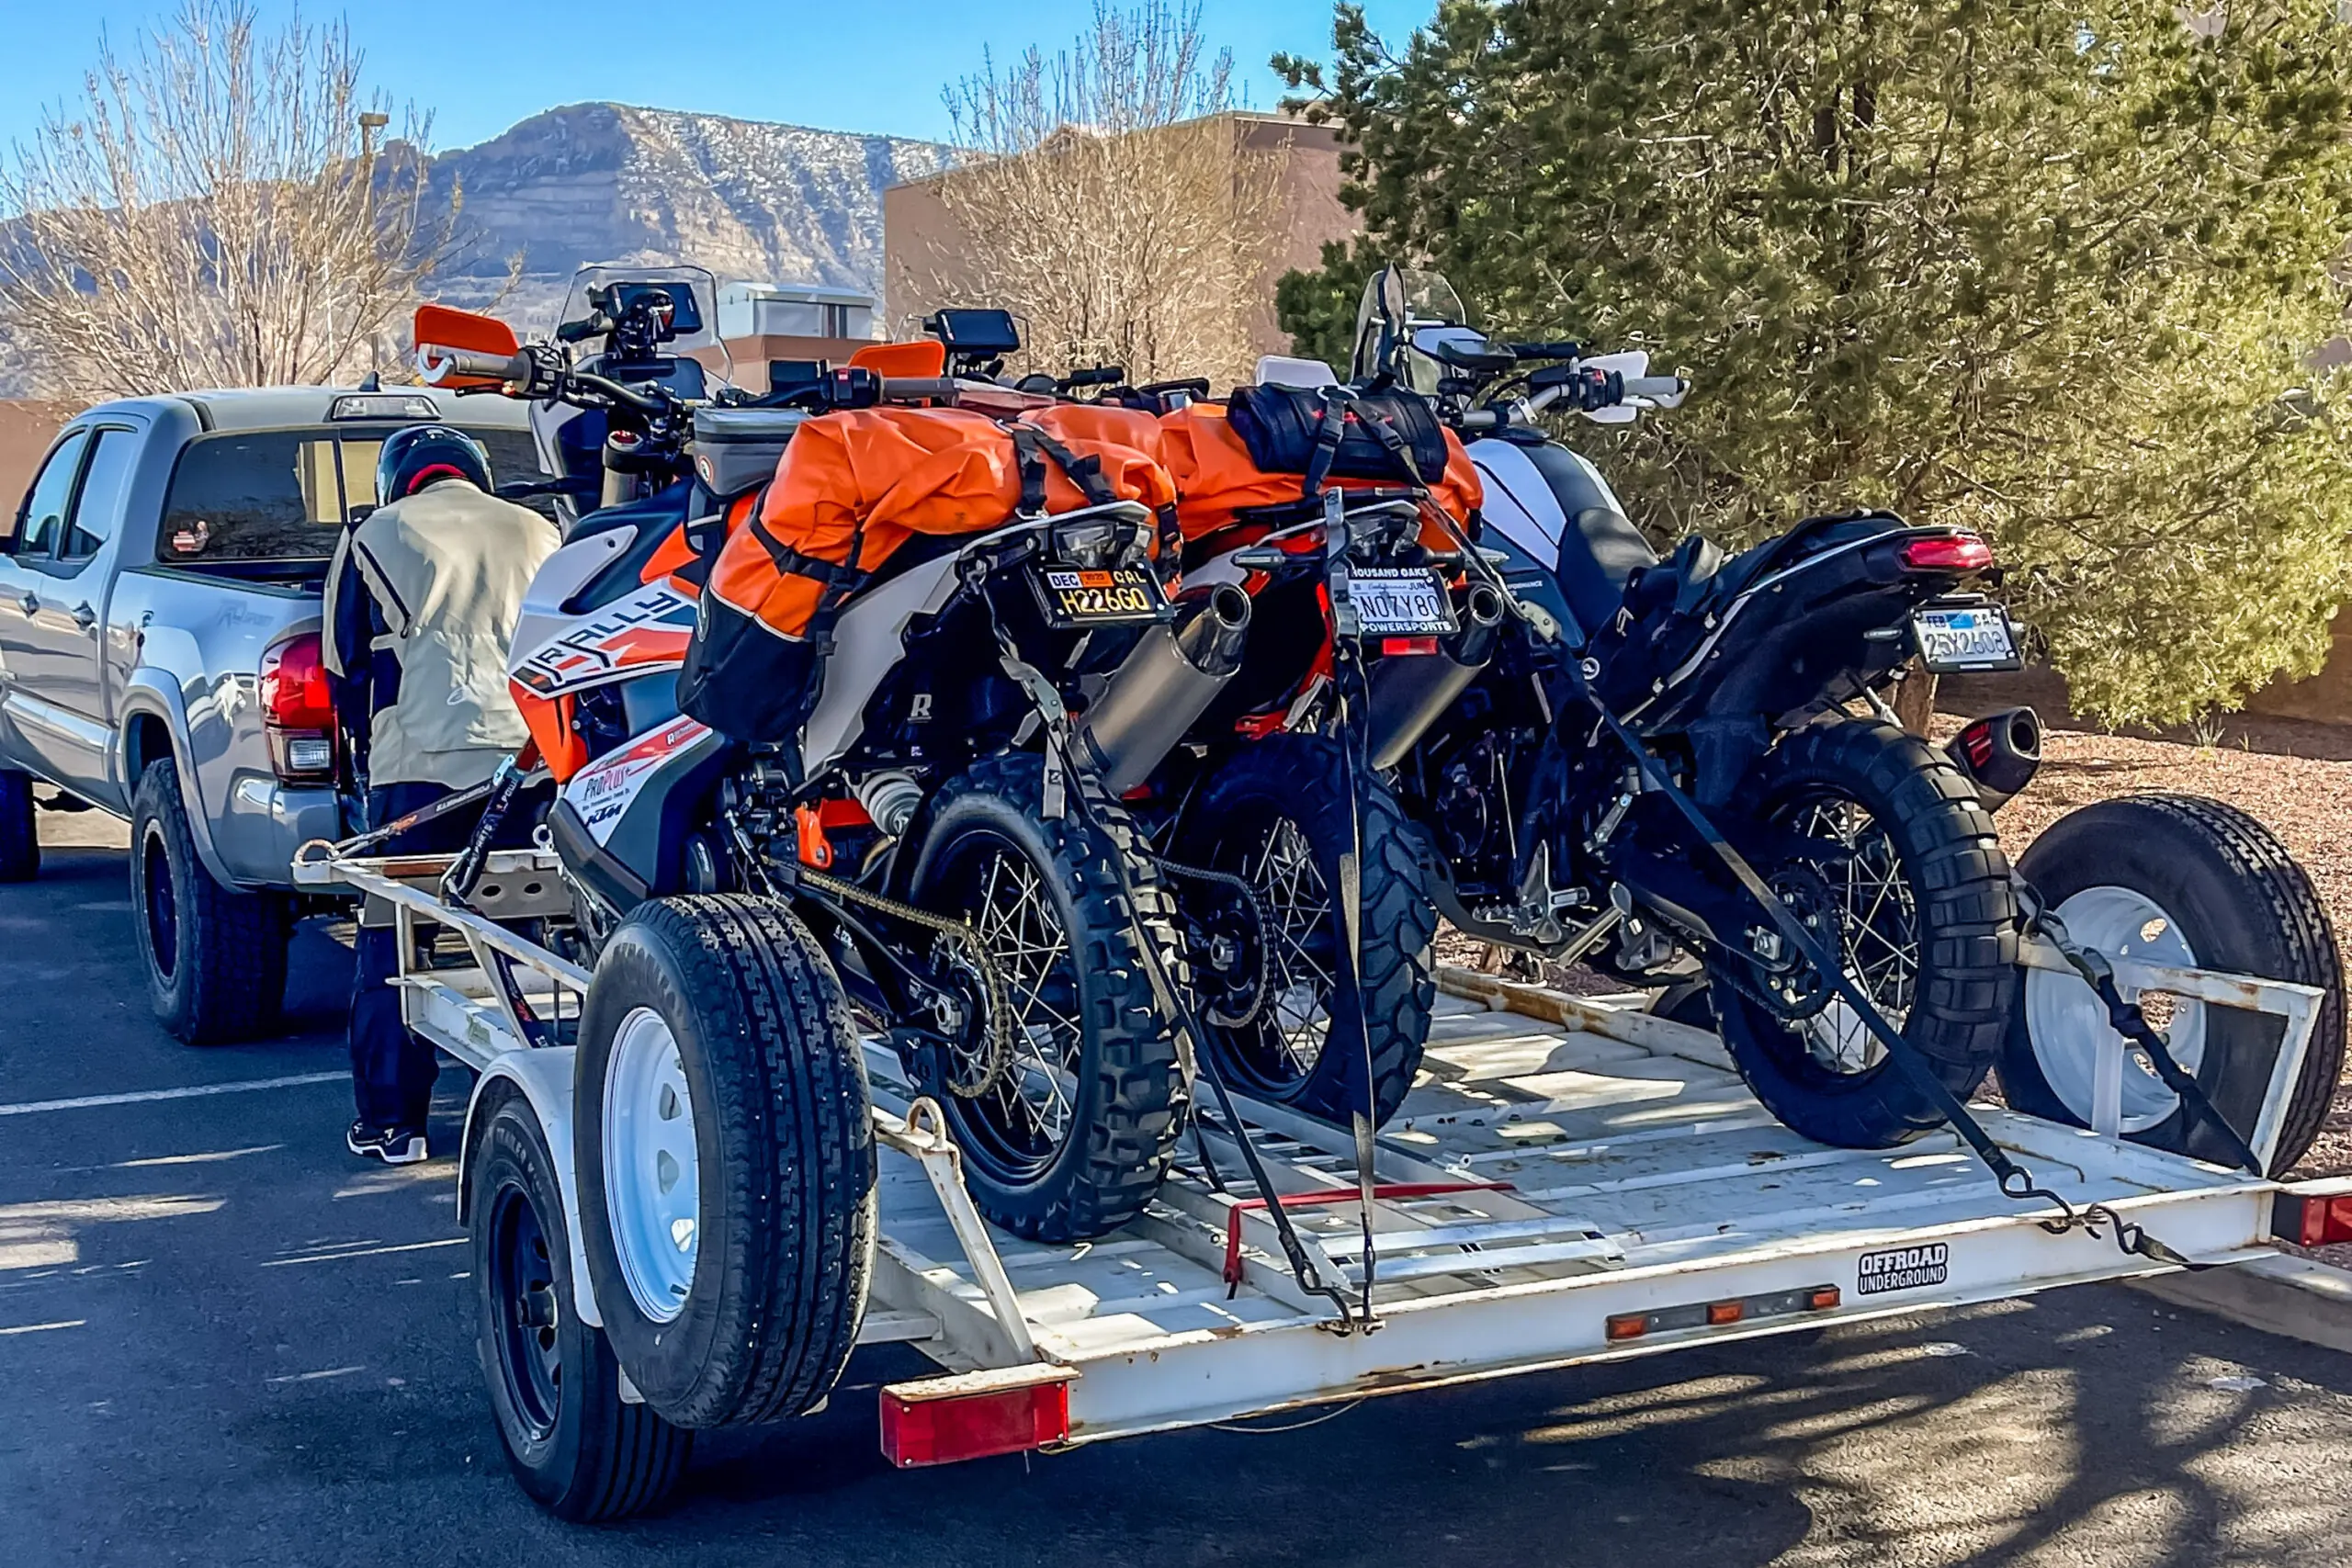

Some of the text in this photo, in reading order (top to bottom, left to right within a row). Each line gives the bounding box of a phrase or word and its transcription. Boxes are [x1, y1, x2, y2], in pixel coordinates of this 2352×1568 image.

[1051, 574, 1079, 587] DEC
[1114, 570, 1148, 584] CAL
[1400, 568, 1430, 577] OAKS
[535, 591, 683, 665] RALLY
[1360, 621, 1453, 633] POWERSPORTS
[910, 694, 933, 717] R
[586, 803, 624, 826] KTM
[1860, 1245, 1947, 1275] OFFROAD
[1860, 1265, 1945, 1293] UNDERGROUND
